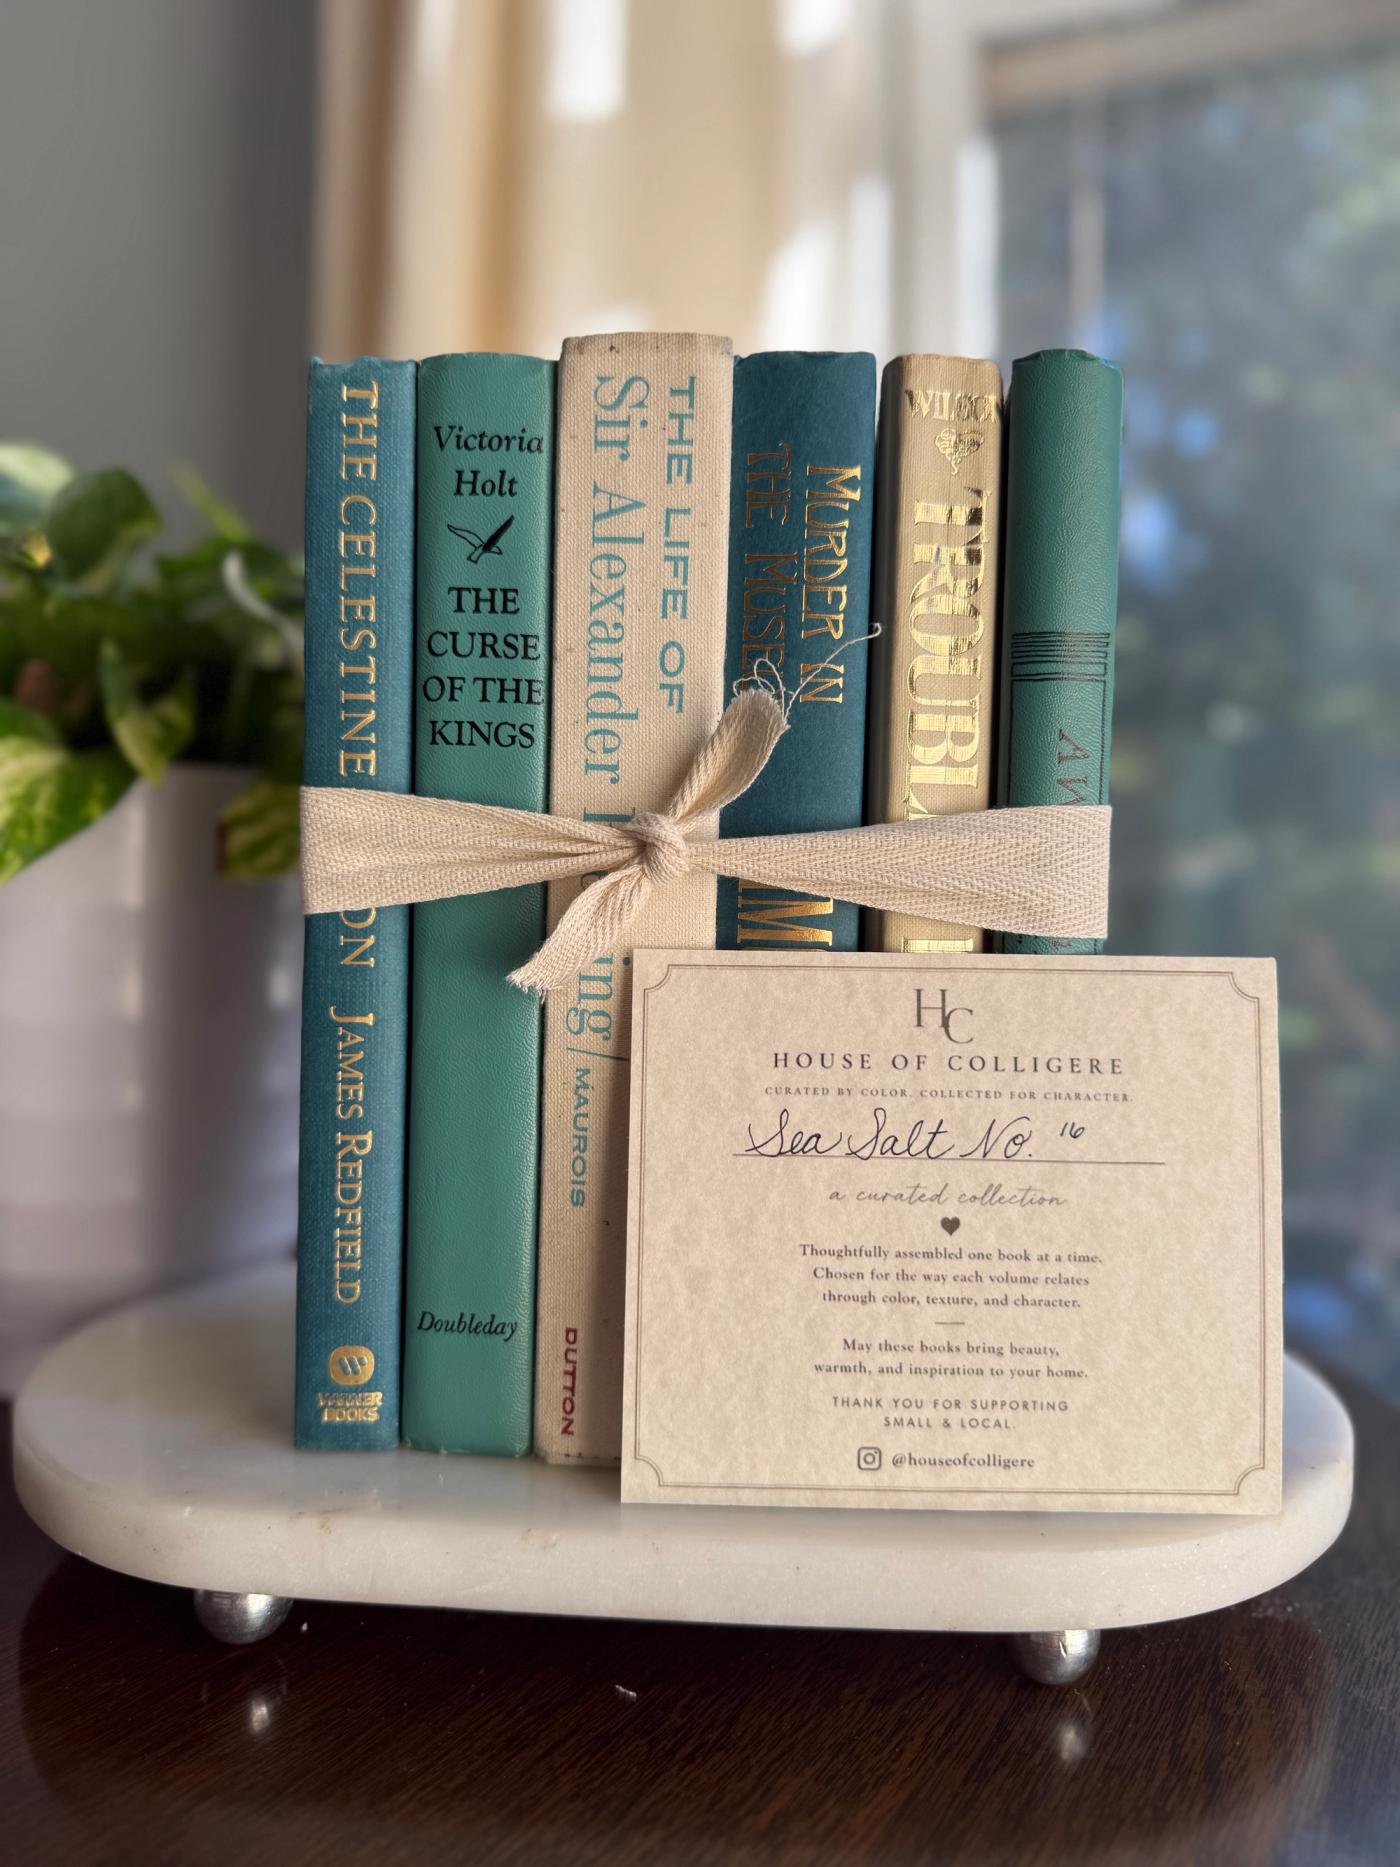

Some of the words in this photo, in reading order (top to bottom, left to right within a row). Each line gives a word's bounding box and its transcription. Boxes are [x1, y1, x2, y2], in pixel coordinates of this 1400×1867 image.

[341, 380, 379, 481] THE
[593, 375, 650, 462] Sir
[665, 376, 696, 485] THE
[433, 425, 544, 455] Victoria
[453, 470, 518, 497] Holt
[745, 440, 793, 529] THE
[660, 507, 691, 620] LIFE
[801, 463, 862, 640] MURDER
[448, 586, 520, 615] THE
[337, 494, 377, 777] CELESTINE
[584, 481, 646, 786] Alexander
[740, 551, 799, 690] MUSE
[426, 631, 541, 661] CURSE
[903, 486, 992, 821] TROUBL
[422, 676, 466, 703] OF
[474, 677, 545, 705] THE
[658, 641, 685, 714] OF
[799, 663, 845, 704] IN
[429, 721, 536, 749] KINGS
[328, 1004, 376, 1121] JAMES
[773, 1052, 872, 1070] HOUSE
[891, 1054, 928, 1071] OF
[948, 1055, 1124, 1075] COLLIGERE
[765, 1086, 830, 1096] CURATED
[837, 1087, 853, 1096] BY
[920, 1089, 1001, 1099] COLLECTED
[1009, 1090, 1036, 1100] FOR
[570, 1067, 589, 1208] MAUROIS
[746, 1108, 843, 1158] Sea
[845, 1107, 956, 1161] Salt
[960, 1116, 1033, 1159] No.
[1059, 1121, 1085, 1140] 16
[828, 1190, 844, 1202] a
[856, 1183, 949, 1206] curated
[957, 1184, 1066, 1207] collection
[334, 1129, 373, 1304] REDFIELD
[800, 1243, 890, 1261] Thoughtfully
[895, 1246, 963, 1260] assembled
[968, 1251, 993, 1261] one
[998, 1248, 1031, 1262] book
[1037, 1252, 1050, 1262] at
[1055, 1253, 1062, 1262] a
[1067, 1251, 1102, 1264] time.
[813, 1266, 864, 1280] Chosen
[870, 1268, 890, 1280] for
[896, 1269, 917, 1282] the
[923, 1272, 949, 1285] way
[952, 1270, 983, 1283] each
[989, 1271, 1039, 1285] volume
[1045, 1272, 1090, 1286] relates
[822, 1289, 876, 1305] through
[881, 1291, 921, 1305] color,
[926, 1294, 978, 1306] texture,
[984, 1293, 1009, 1306] and
[1014, 1294, 1081, 1308] character.
[417, 1310, 519, 1342] Doubleday
[842, 1338, 873, 1354] May
[878, 1339, 915, 1353] these
[920, 1340, 961, 1354] books
[966, 1341, 1004, 1357] bring
[1009, 1342, 1060, 1357] beauty,
[560, 1326, 578, 1436] DUTTON
[814, 1360, 872, 1375] warmth,
[878, 1362, 903, 1375] and
[909, 1363, 984, 1379] inspiration
[990, 1367, 1004, 1377] to
[1009, 1368, 1041, 1379] your
[1047, 1365, 1088, 1378] home.
[321, 1406, 380, 1424] BOOKS
[832, 1396, 883, 1408] THANK
[892, 1398, 924, 1409] YOU
[933, 1398, 961, 1410] FOR
[970, 1399, 1069, 1412] SUPPORTING
[884, 1416, 933, 1428] SMALL
[942, 1418, 952, 1429] &
[960, 1417, 1016, 1430] LOCAL.
[892, 1451, 1035, 1470] @houseofcolligere
